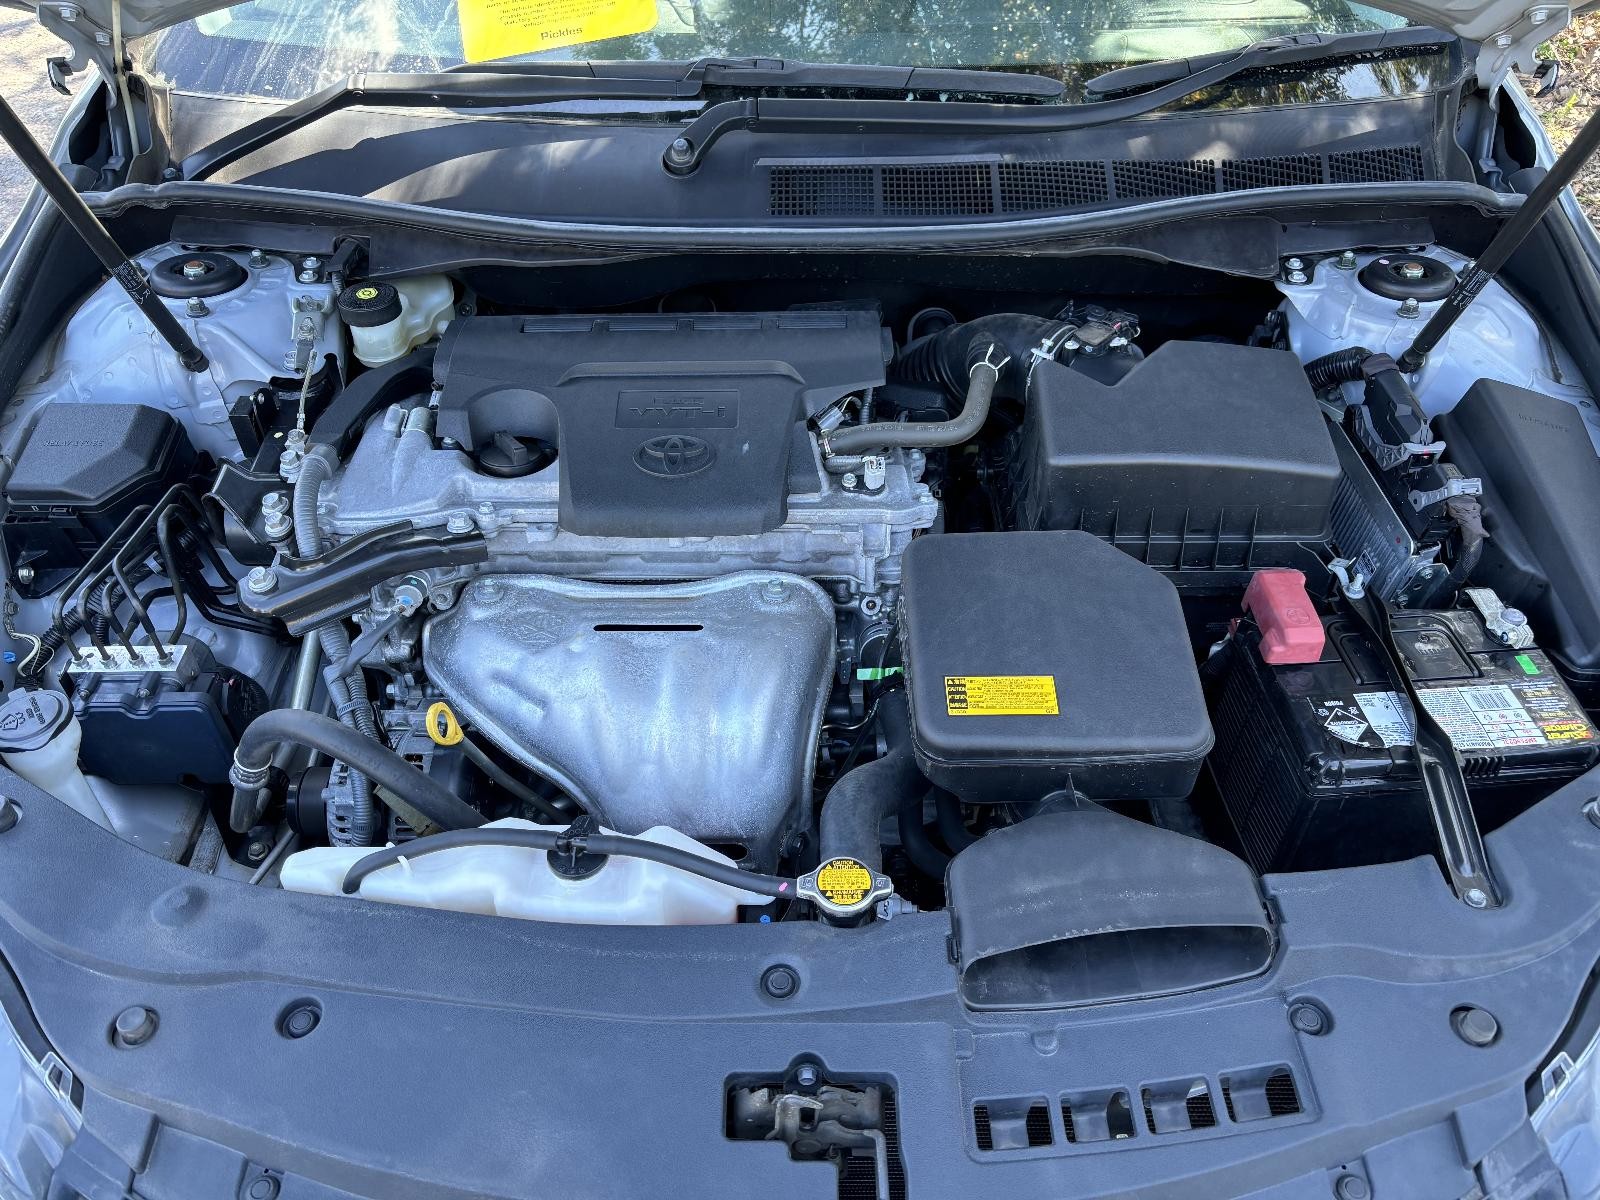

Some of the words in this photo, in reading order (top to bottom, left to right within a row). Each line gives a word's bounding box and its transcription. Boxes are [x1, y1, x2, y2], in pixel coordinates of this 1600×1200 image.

[540, 28, 583, 41] Pickles
[1543, 723, 1587, 732] CHARGE
[1546, 731, 1583, 740] SUPER
